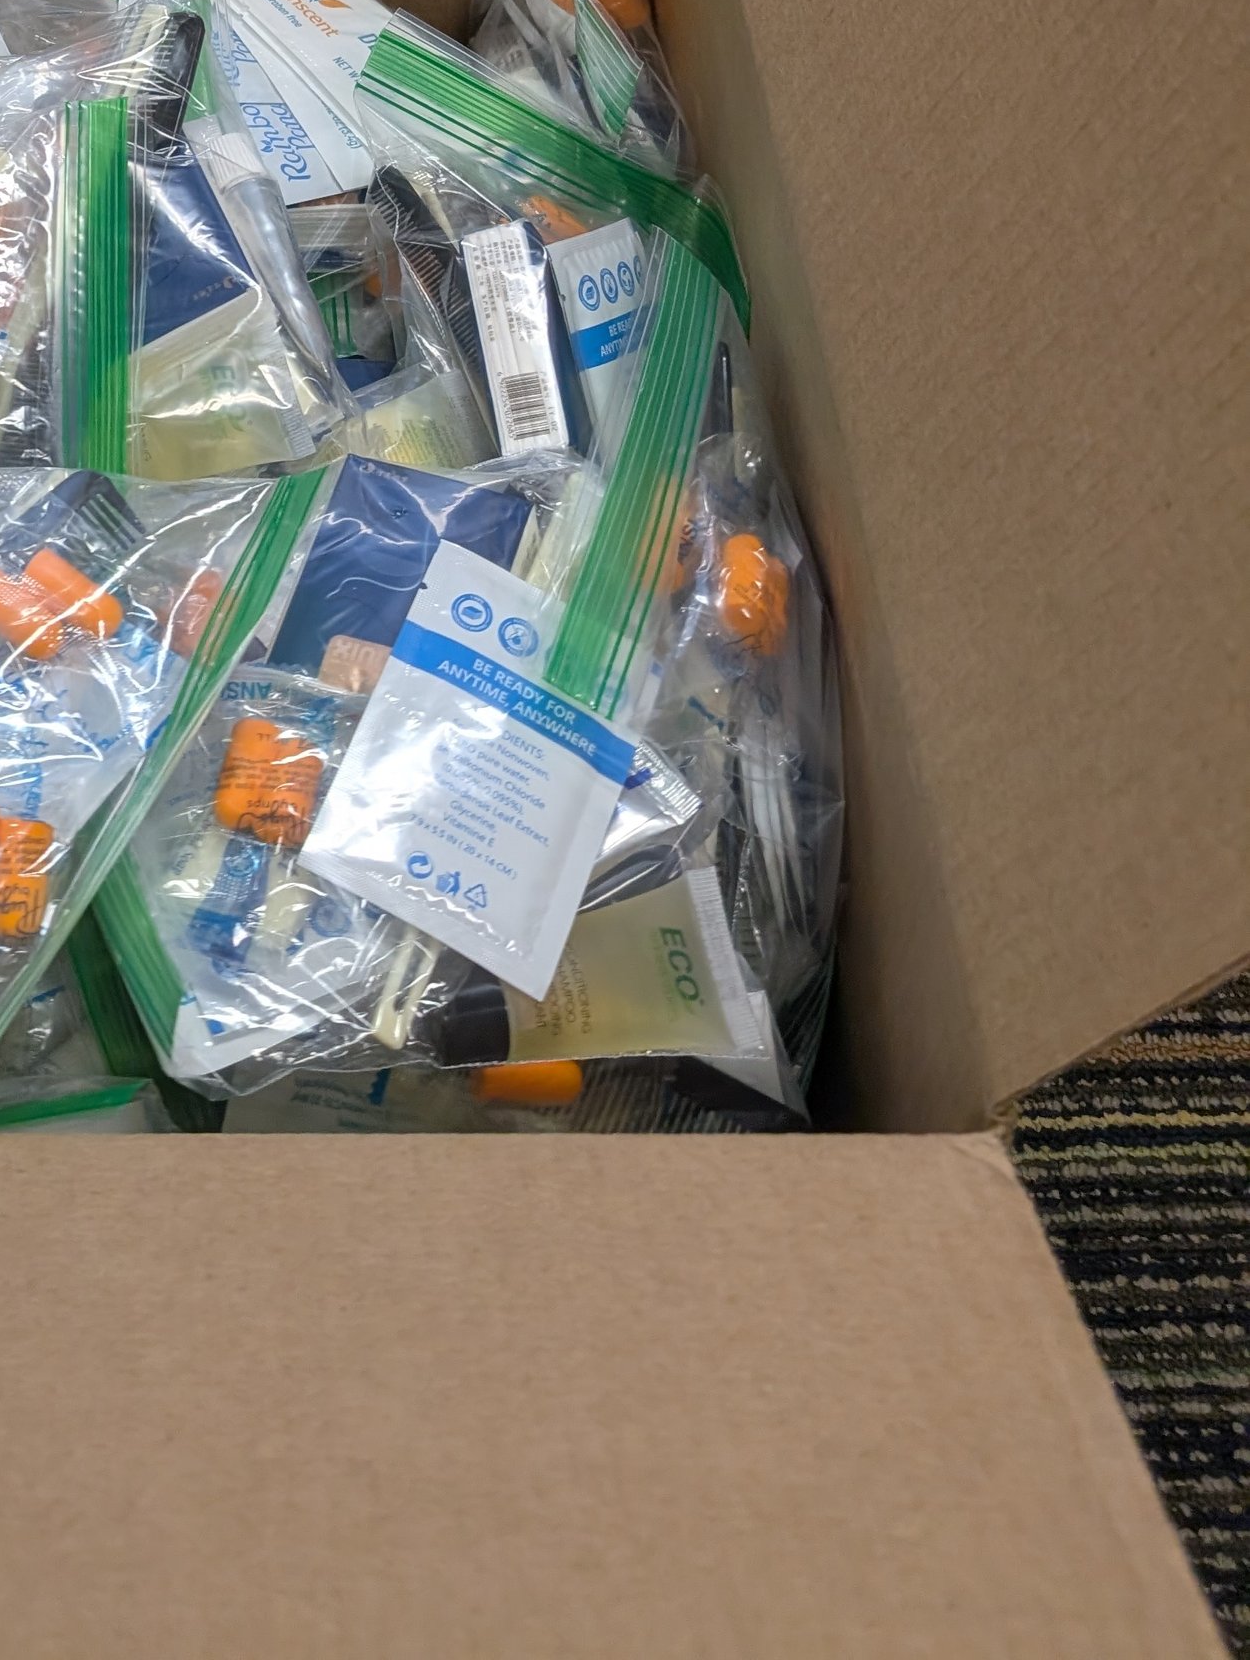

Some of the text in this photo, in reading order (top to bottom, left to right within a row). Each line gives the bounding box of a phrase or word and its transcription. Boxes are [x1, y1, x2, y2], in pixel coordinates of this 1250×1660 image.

[285, 11, 303, 28] free
[332, 56, 352, 74] NET
[240, 103, 312, 183] Rainbo
[437, 659, 510, 708] ANYTIME,
[511, 701, 598, 757] ANYWHERE
[472, 658, 577, 724] BE READY FOR
[477, 750, 502, 769] pure
[501, 765, 531, 787] water,
[503, 780, 547, 810] Chloride
[443, 812, 496, 848] Vitamine E
[450, 799, 498, 834] Glycerine,
[658, 926, 699, 1002] ECO
